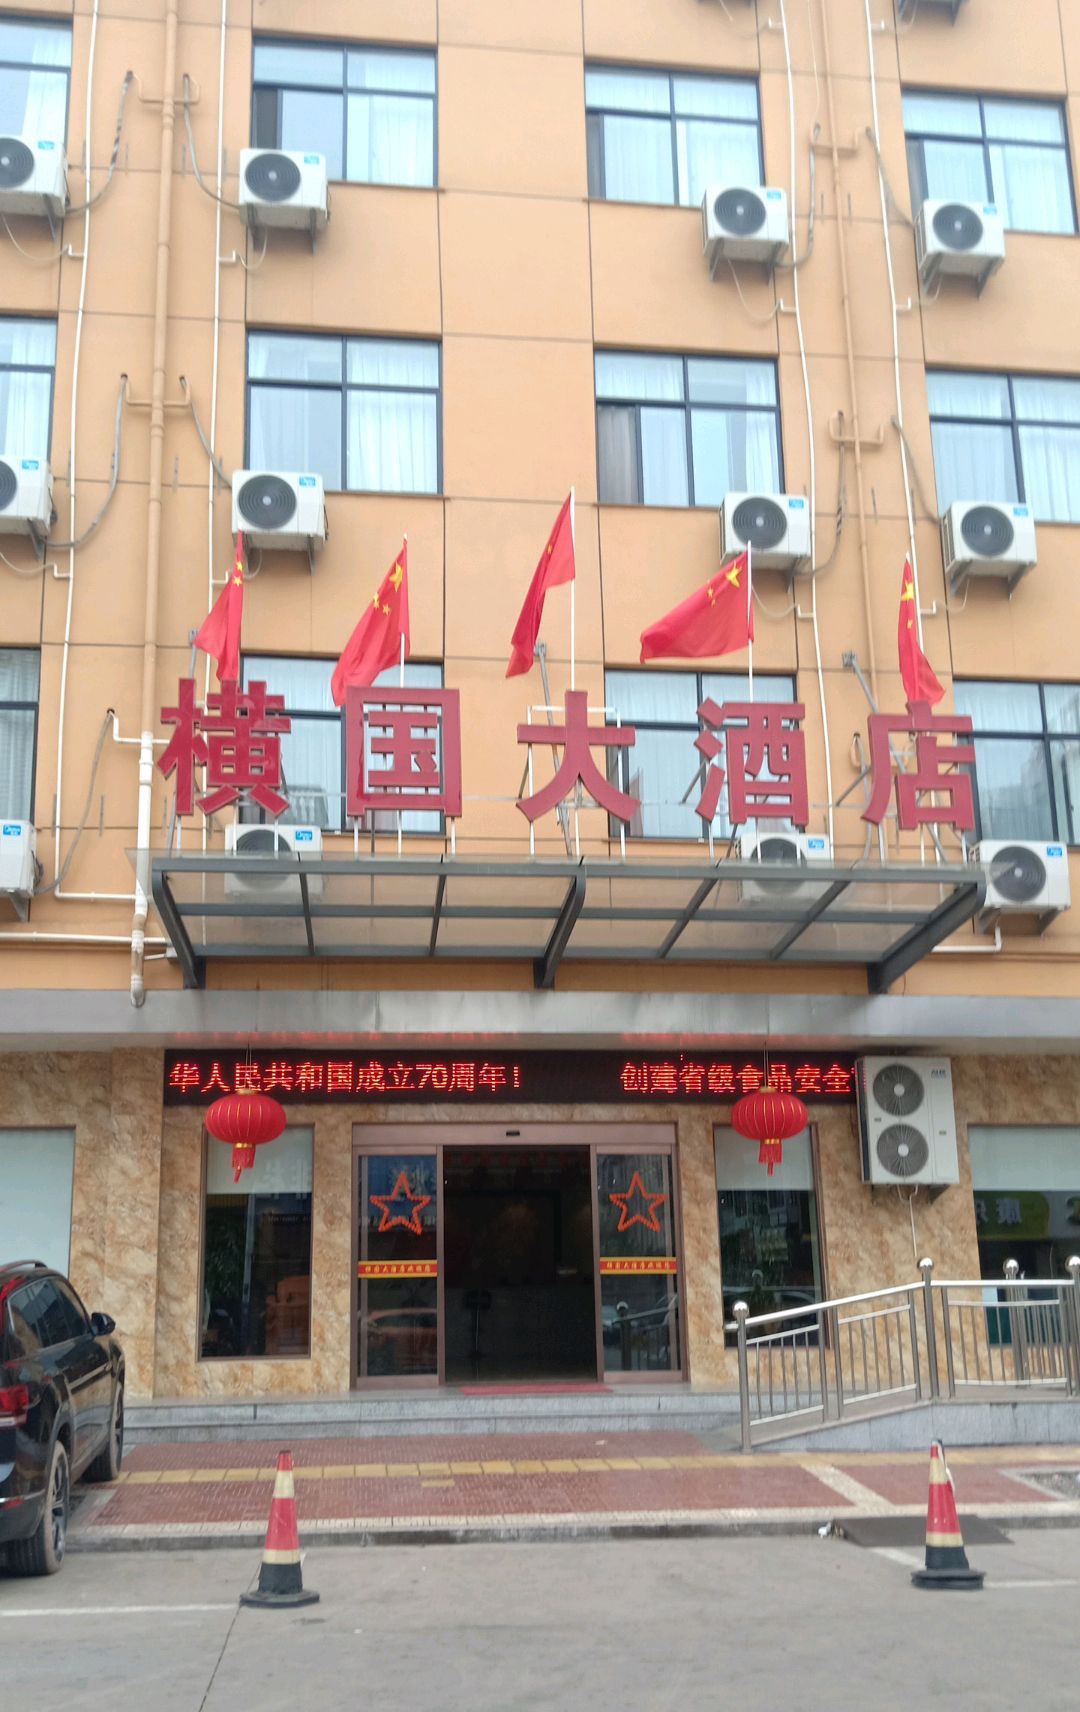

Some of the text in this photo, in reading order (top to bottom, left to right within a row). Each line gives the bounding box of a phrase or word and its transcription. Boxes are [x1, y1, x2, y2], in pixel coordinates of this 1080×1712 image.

[157, 679, 976, 830] 横国大酒店
